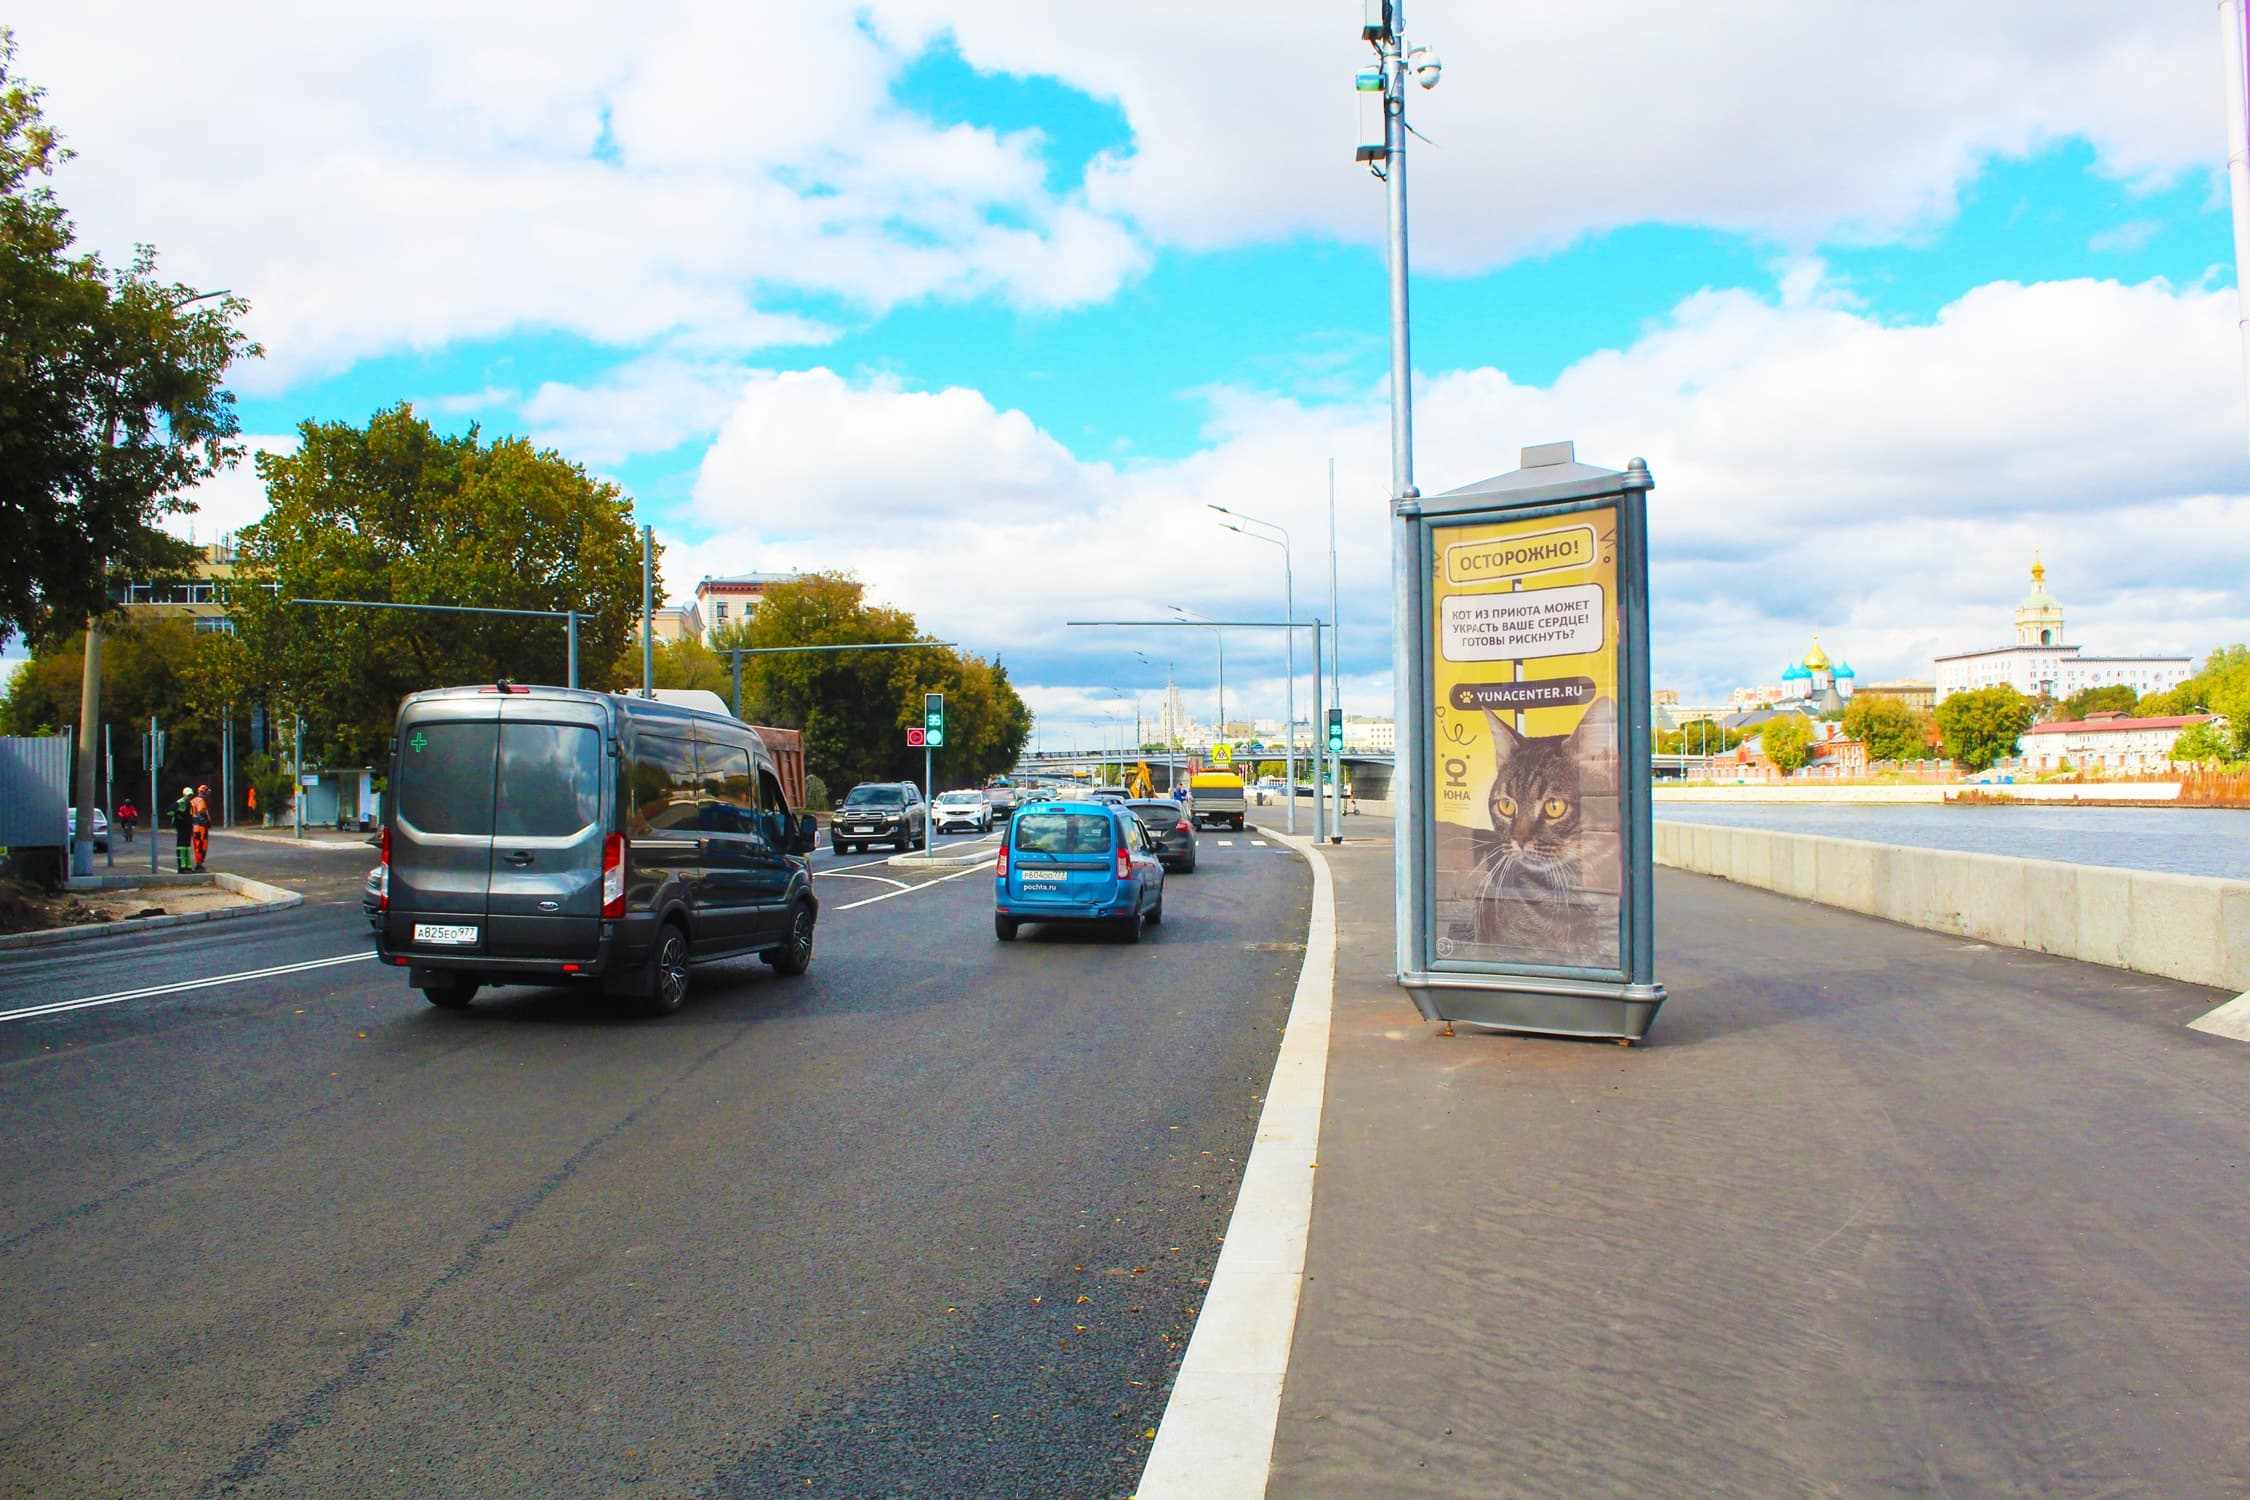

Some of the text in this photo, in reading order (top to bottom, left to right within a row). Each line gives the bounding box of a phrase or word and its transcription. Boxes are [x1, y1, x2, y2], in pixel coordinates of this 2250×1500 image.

[1460, 540, 1579, 570] ОСТОРОЖНО!
[1452, 600, 1590, 620] КОТ ИЗ ПРИЮТА МОЖЕТ
[1452, 614, 1589, 633] УКРАСТЬ ВАШЕ СЕРДЦЕ!
[1462, 629, 1575, 647] ГОТОВЫ РИСКНУТЬ?
[1476, 685, 1583, 702] YUNACENTER.RU
[1443, 789, 1471, 801] ЮНА
[1023, 883, 1057, 892] pochta.ru
